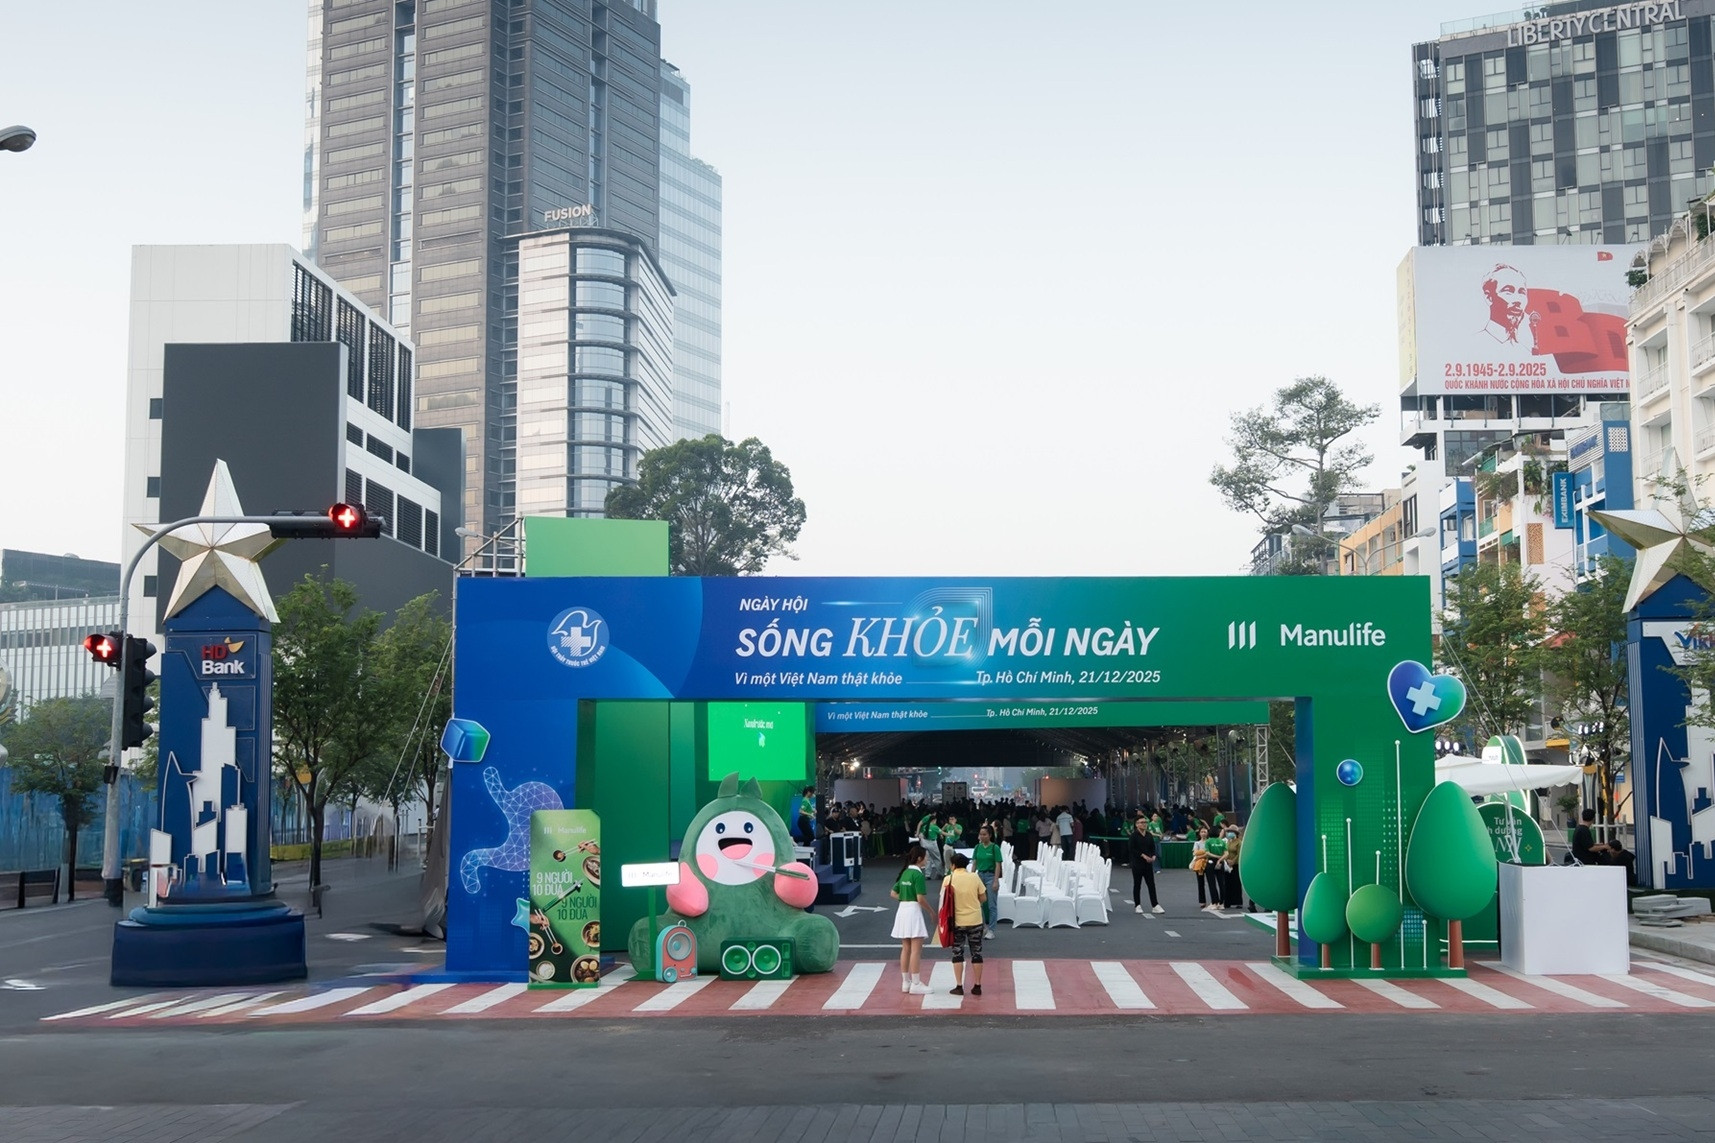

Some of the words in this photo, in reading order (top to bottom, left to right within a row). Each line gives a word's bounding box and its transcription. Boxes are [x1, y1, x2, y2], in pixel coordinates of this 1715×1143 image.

[544, 203, 592, 222] FUSION
[1444, 362, 1547, 377] 2.9.1945-2.9.2025
[1444, 377, 1463, 390] QUỐC
[1465, 377, 1488, 390] KHÁNH
[1490, 377, 1509, 390] NƯỚC
[1511, 377, 1529, 391] CỘNG
[1547, 377, 1556, 389] XÃ
[1558, 377, 1569, 391] HỘI
[1571, 376, 1586, 389] CHỦ
[1587, 377, 1608, 389] NGHĨA
[1609, 377, 1624, 391] VIỆT
[1560, 477, 1569, 523] EXIMBANK
[739, 597, 779, 612] NGÀY
[782, 596, 808, 613] HỘI
[735, 618, 833, 657] SỐNG
[842, 605, 979, 658] KHỎE
[988, 617, 1056, 657] MỖI
[1063, 620, 1161, 656] NGÀY
[1280, 622, 1386, 647] Manulife
[202, 645, 227, 660] HD
[202, 660, 245, 674] Bank
[735, 672, 748, 685] Vì
[750, 673, 776, 687] một
[779, 672, 805, 687] Việt
[807, 673, 838, 685] Nam
[841, 672, 869, 687] thật
[870, 671, 903, 685] khỏe
[976, 670, 993, 686] Tp.
[995, 670, 1013, 684] Hồ
[1016, 671, 1036, 684] Chí
[1040, 671, 1075, 685] Minh,
[1078, 670, 1162, 684] 21/12/2025
[827, 711, 836, 720] Vì
[837, 711, 853, 721] một
[854, 710, 870, 720] Việt
[871, 710, 890, 720] Nam
[891, 710, 908, 721] thật
[908, 709, 929, 720] khỏe
[986, 708, 998, 717] Tp.
[999, 707, 1011, 717] Hồ
[1011, 707, 1026, 717] Chí
[1026, 707, 1048, 717] Minh,
[1049, 706, 1099, 716] 21/12/2025
[536, 871, 543, 884] 9
[544, 868, 573, 884] NGƯỜI
[532, 884, 543, 896] 10
[569, 893, 597, 909] NGƯỜI
[557, 909, 568, 920] 10
